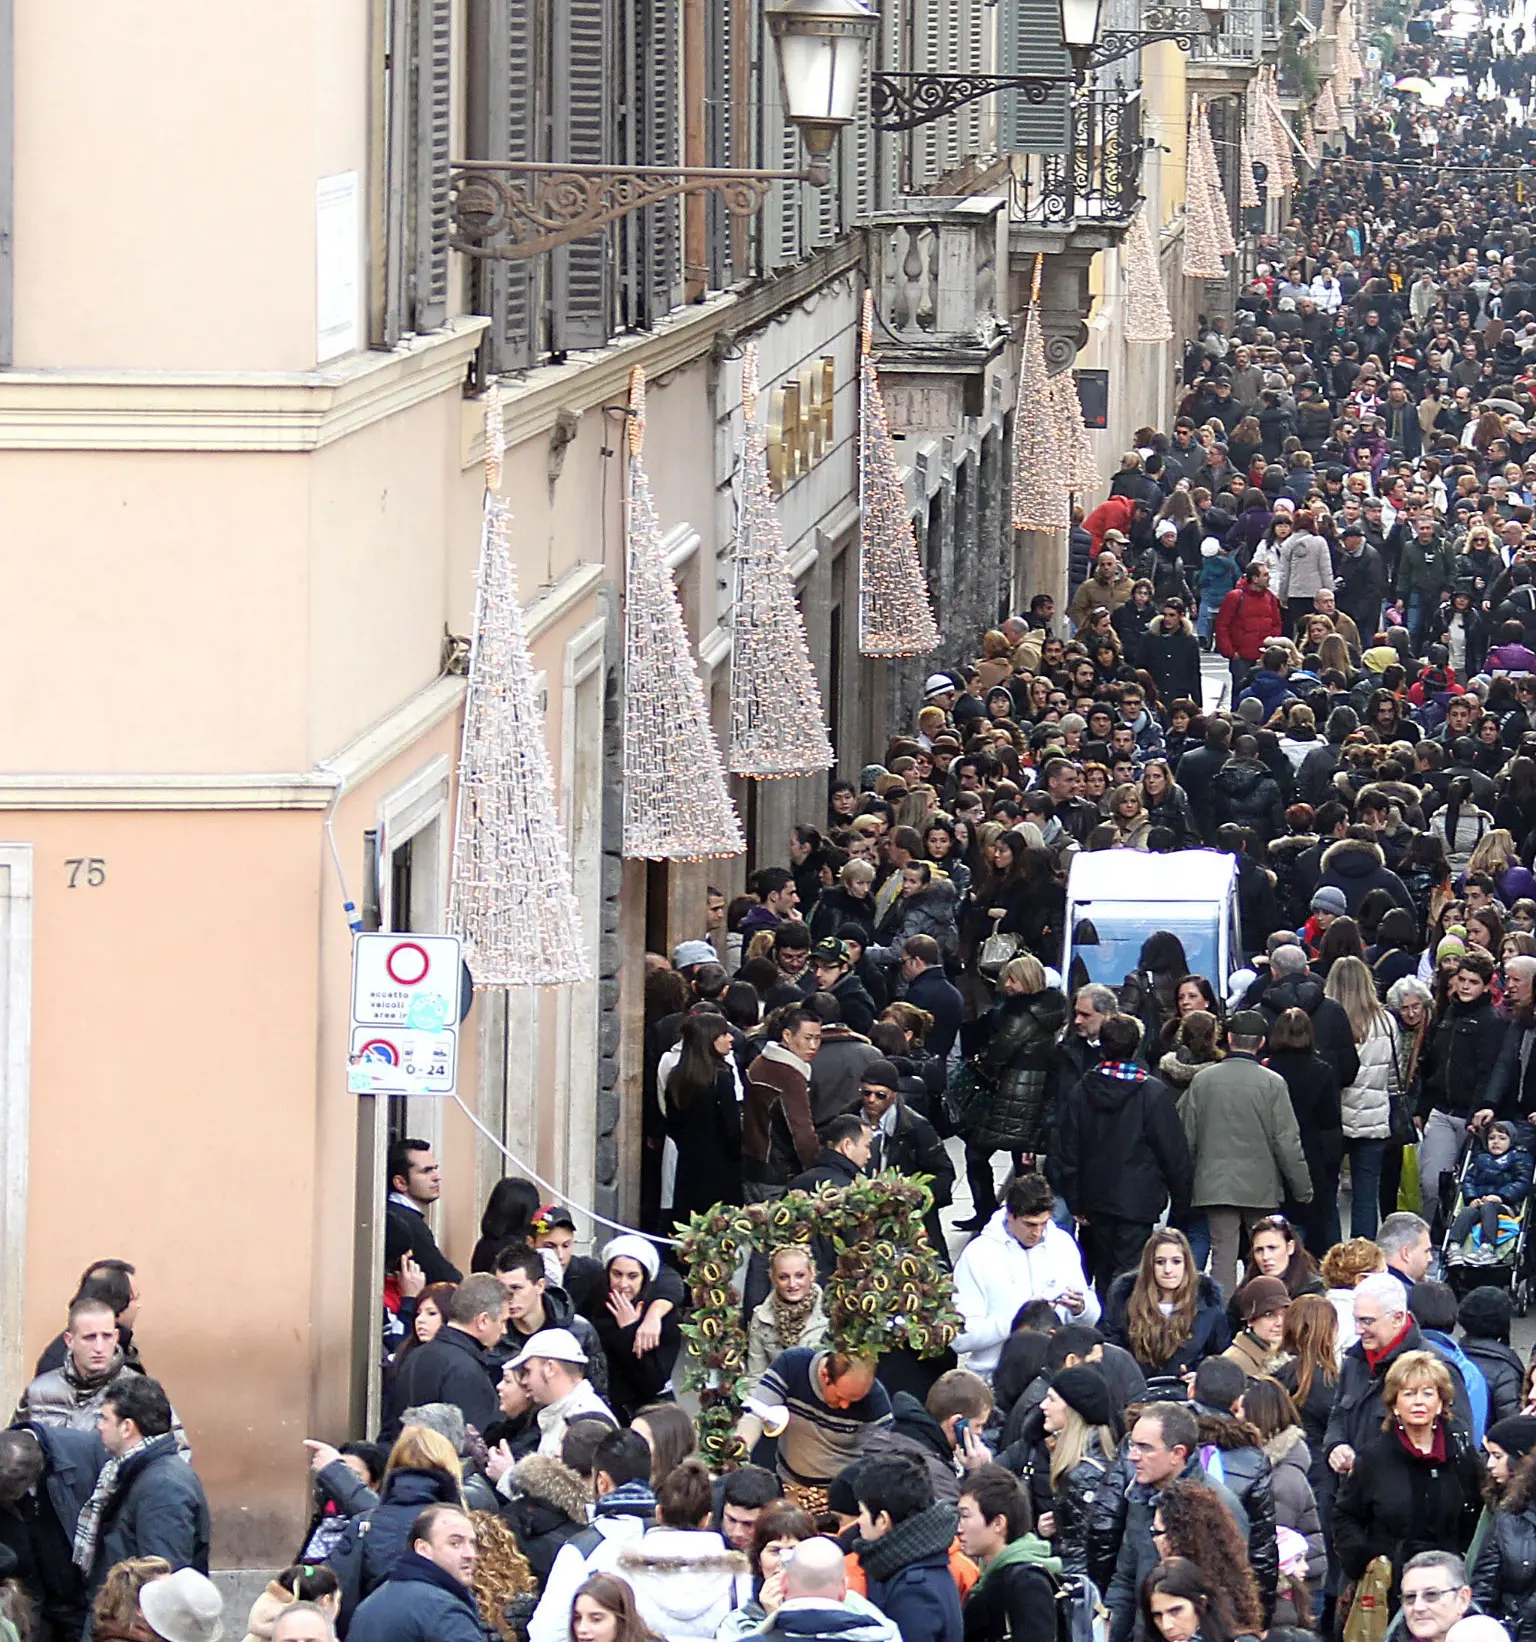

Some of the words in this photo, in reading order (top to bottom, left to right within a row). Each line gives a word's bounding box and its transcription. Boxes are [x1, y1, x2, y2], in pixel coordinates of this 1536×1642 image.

[64, 858, 107, 888] 75
[370, 991, 409, 999] eccetto
[370, 1001, 405, 1009] veicoli
[373, 1011, 396, 1019] aree
